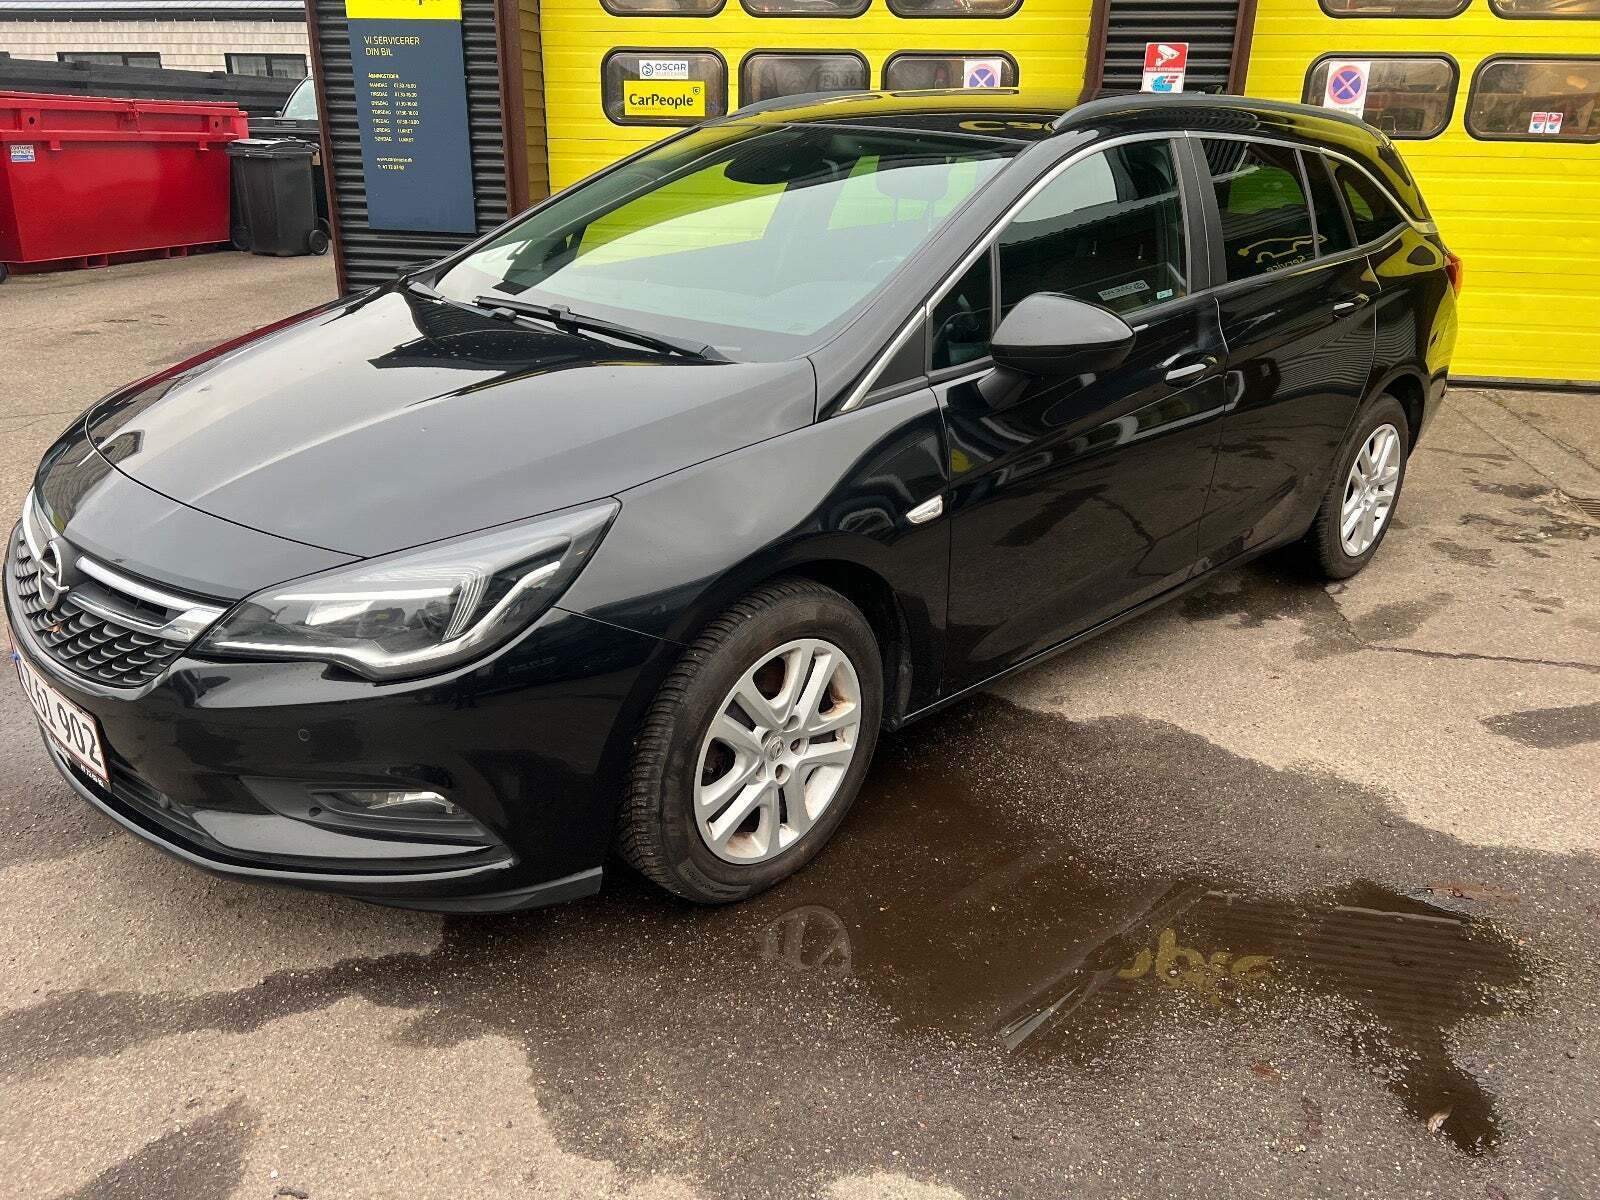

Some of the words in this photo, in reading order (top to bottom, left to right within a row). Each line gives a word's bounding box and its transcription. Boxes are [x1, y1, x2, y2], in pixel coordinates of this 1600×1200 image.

[363, 36, 372, 45] VI
[374, 36, 421, 45] SERVICERER
[365, 48, 380, 56] DIN
[380, 48, 393, 56] BIL
[654, 63, 687, 71] OSCAR
[628, 93, 694, 109] CarPeople
[56, 702, 102, 768] 902
